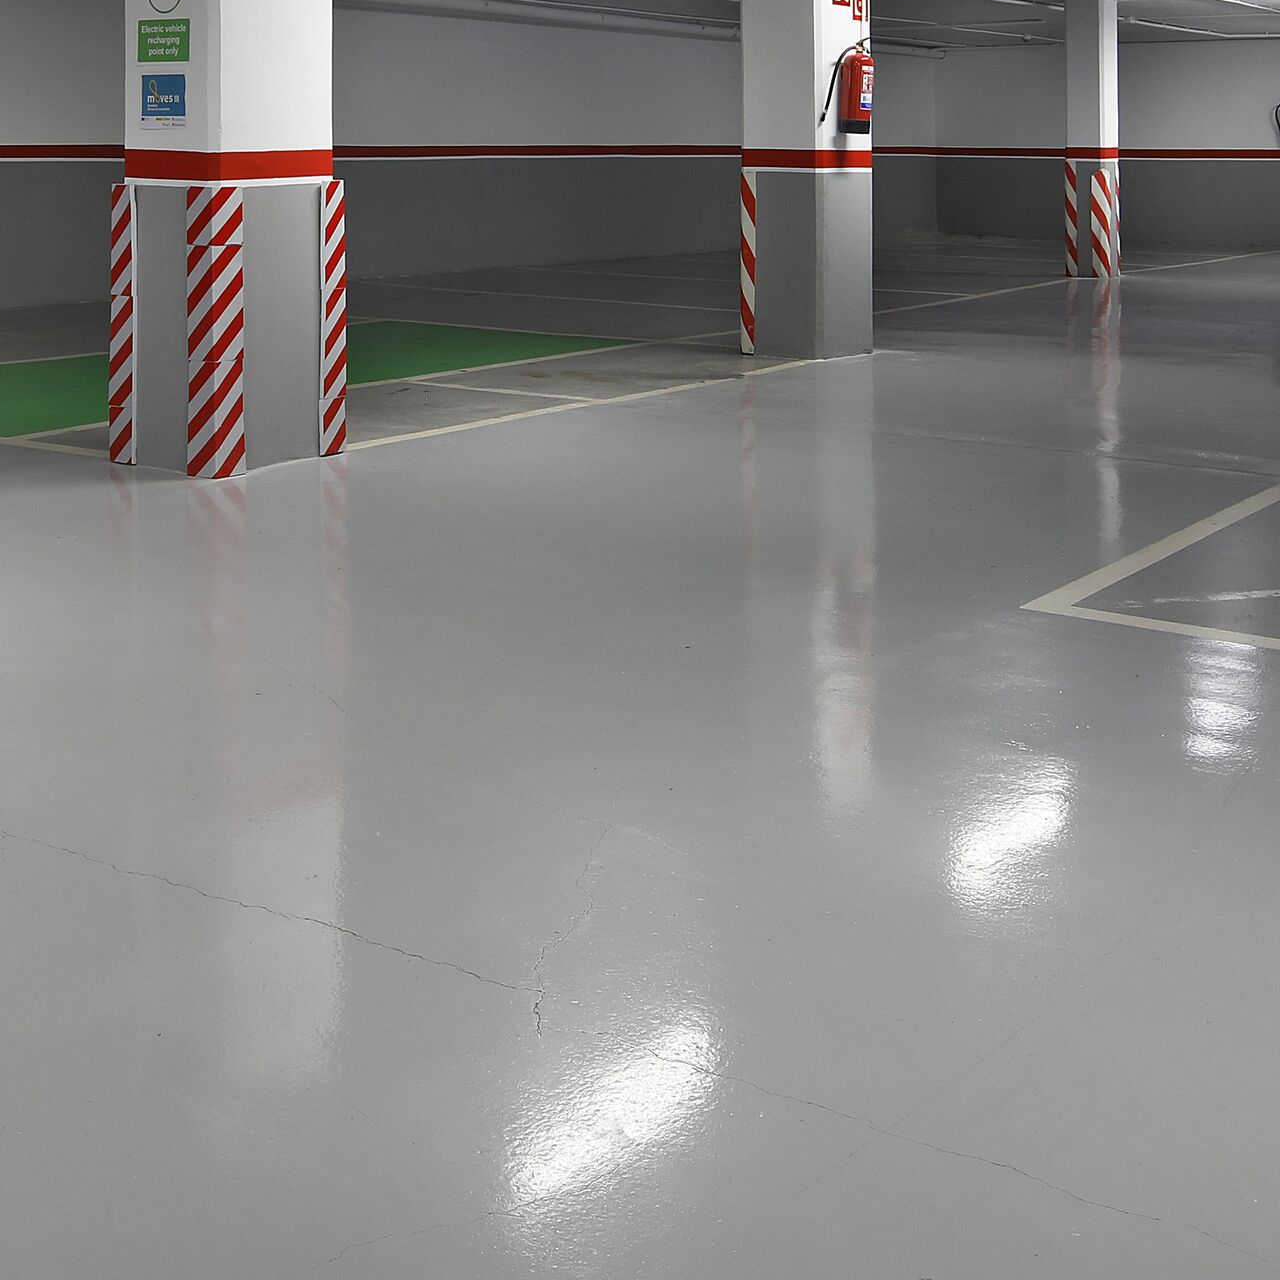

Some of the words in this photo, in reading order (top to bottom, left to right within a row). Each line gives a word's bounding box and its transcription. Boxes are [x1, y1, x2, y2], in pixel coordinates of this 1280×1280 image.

[141, 25, 163, 33] Electric
[165, 24, 187, 32] vehicle
[148, 36, 180, 45] recharging
[148, 47, 165, 56] point
[165, 46, 179, 56] only
